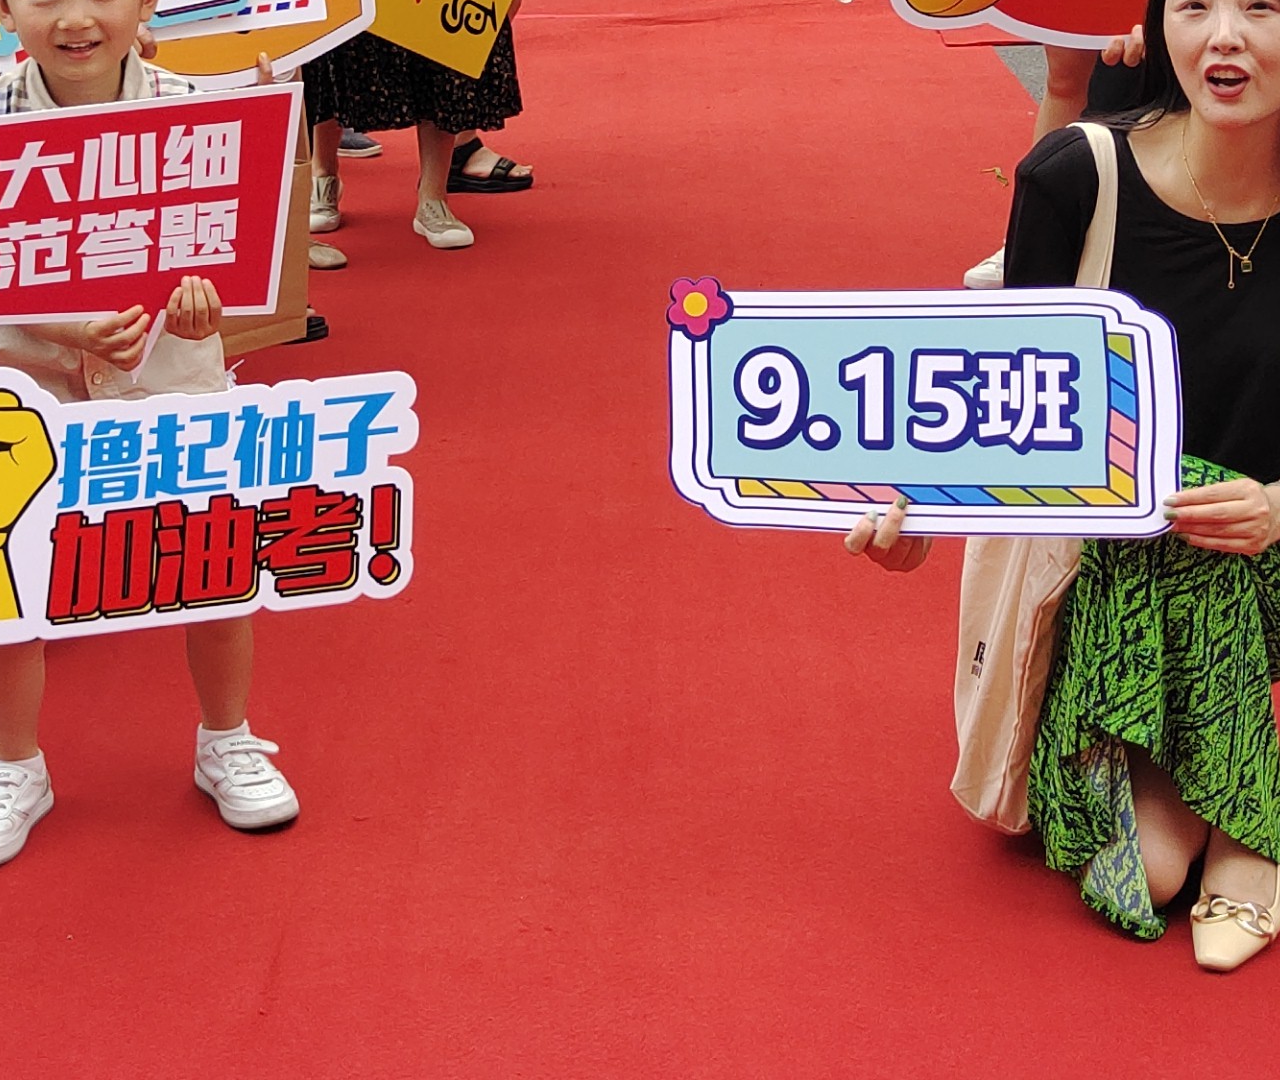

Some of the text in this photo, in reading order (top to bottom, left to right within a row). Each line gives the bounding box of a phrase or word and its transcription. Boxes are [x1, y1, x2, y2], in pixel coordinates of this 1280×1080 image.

[55, 389, 401, 510] 撸起袖子
[733, 344, 1084, 455] 9.15班
[46, 482, 402, 626] 加油考!
